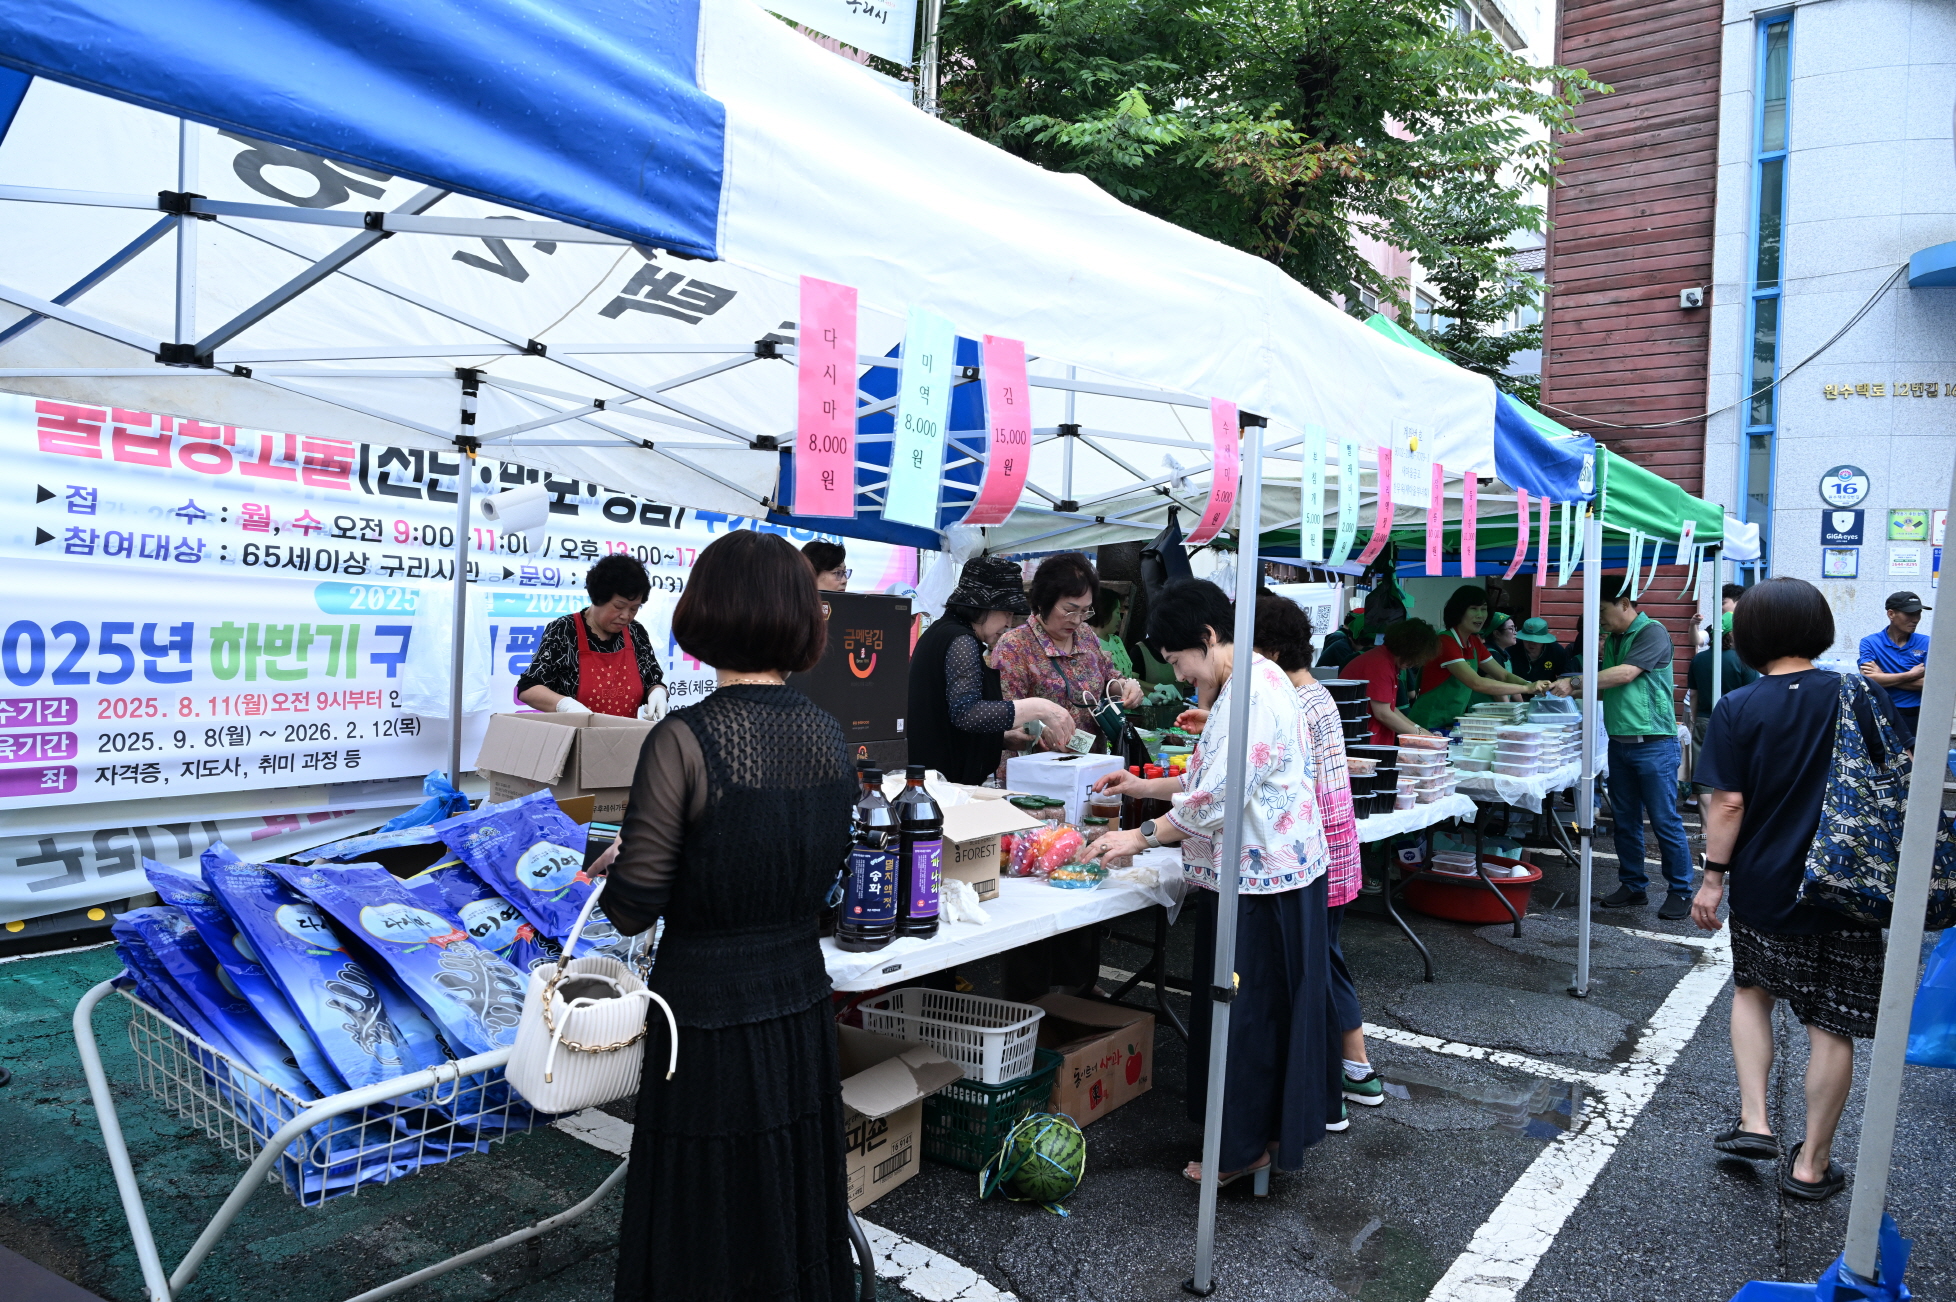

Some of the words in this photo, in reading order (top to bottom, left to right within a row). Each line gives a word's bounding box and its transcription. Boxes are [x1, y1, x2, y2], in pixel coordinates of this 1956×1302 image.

[823, 327, 838, 421] 다시마
[919, 353, 933, 406] 미역
[1002, 387, 1014, 405] 김
[1823, 382, 1886, 401] 원수택로
[1892, 380, 1939, 398] 12번길
[904, 413, 937, 438] 8,000
[994, 427, 1027, 446] 15,000
[808, 433, 847, 455] 8,000
[911, 448, 923, 469] 원
[1002, 458, 1014, 476] 원
[820, 470, 834, 491] 원
[1830, 483, 1858, 494] 16
[1215, 489, 1232, 503] 5,000
[65, 485, 98, 516] 접
[175, 499, 206, 525] 수
[330, 516, 384, 543] 오전
[559, 537, 599, 561] 오후
[1306, 512, 1320, 525] 5,000
[63, 525, 207, 564] 참여대상
[242, 542, 371, 576] 65세이상
[518, 564, 561, 588] 문의
[843, 628, 883, 650] 금메달김
[209, 620, 361, 682] 하반기
[97, 697, 168, 720] 2025.
[178, 696, 201, 718] 8.
[316, 688, 383, 711] 9시부터
[98, 731, 163, 753] 2025.
[173, 729, 195, 749] 9.
[204, 724, 252, 748] 8(월)
[284, 722, 338, 743] 2026.
[346, 720, 364, 739] 2.
[372, 716, 422, 738] 12(목)
[40, 767, 68, 790] 좌
[94, 761, 170, 786] 자격증,
[180, 757, 248, 780] 지도사,
[258, 752, 295, 775] 취미
[301, 750, 338, 771] 과정
[343, 749, 362, 769] 등
[962, 843, 997, 862] FOREST
[868, 870, 882, 895] 송화
[1100, 1048, 1123, 1070] 사과
